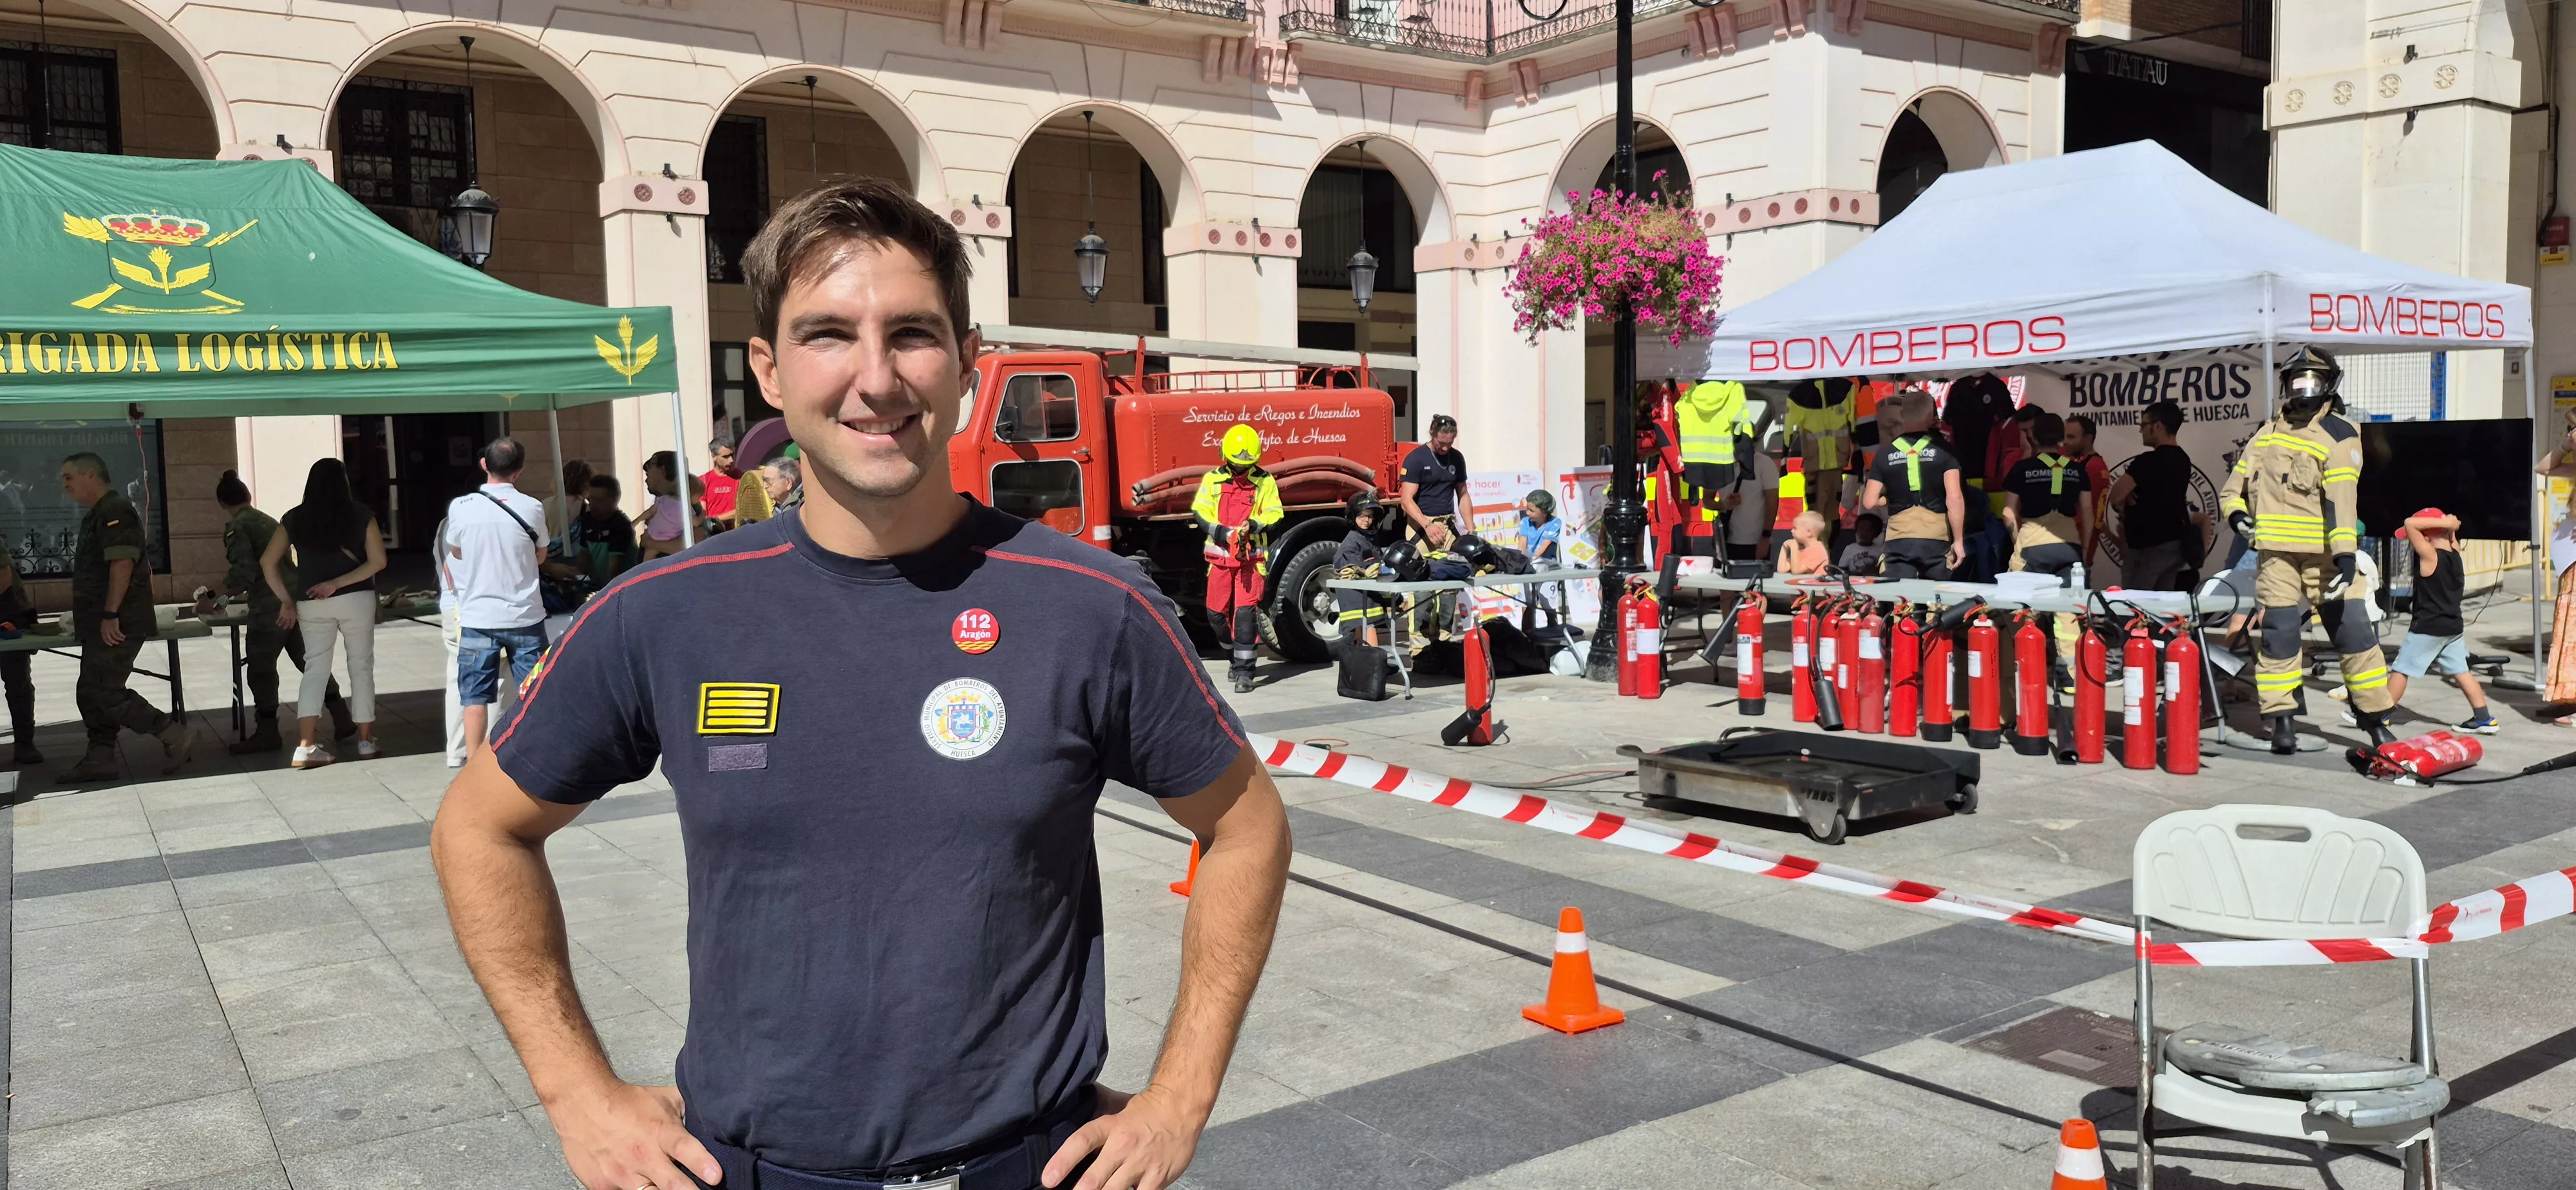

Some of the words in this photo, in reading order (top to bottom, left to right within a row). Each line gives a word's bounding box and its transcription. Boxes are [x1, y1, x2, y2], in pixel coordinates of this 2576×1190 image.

[2105, 48, 2168, 86] TATAU
[2309, 293, 2505, 339] BOMBEROS
[0, 332, 160, 373] IGADA
[175, 325, 399, 372] LOGÍSTICA
[1749, 316, 2067, 372] BOMBEROS
[2069, 363, 2251, 408] BOMBEROS
[1182, 406, 1235, 423] Servicio
[1237, 404, 1251, 422] de
[1254, 404, 1296, 426] Riegos
[1299, 411, 1305, 419] e
[1307, 402, 1361, 419] Incendios
[2193, 403, 2249, 422] HUESCA
[1287, 428, 1300, 444] de
[1302, 427, 1347, 445] Huesca
[1475, 478, 1502, 489] hacer
[960, 614, 991, 628] 112
[960, 629, 991, 641] Aragón
[954, 679, 988, 691] BOMBEROS
[989, 689, 999, 699] DEL
[923, 690, 942, 721] MUNICIPAL
[988, 702, 1005, 746] AYUNTAMIENTO
[923, 724, 942, 749] SERVICIO
